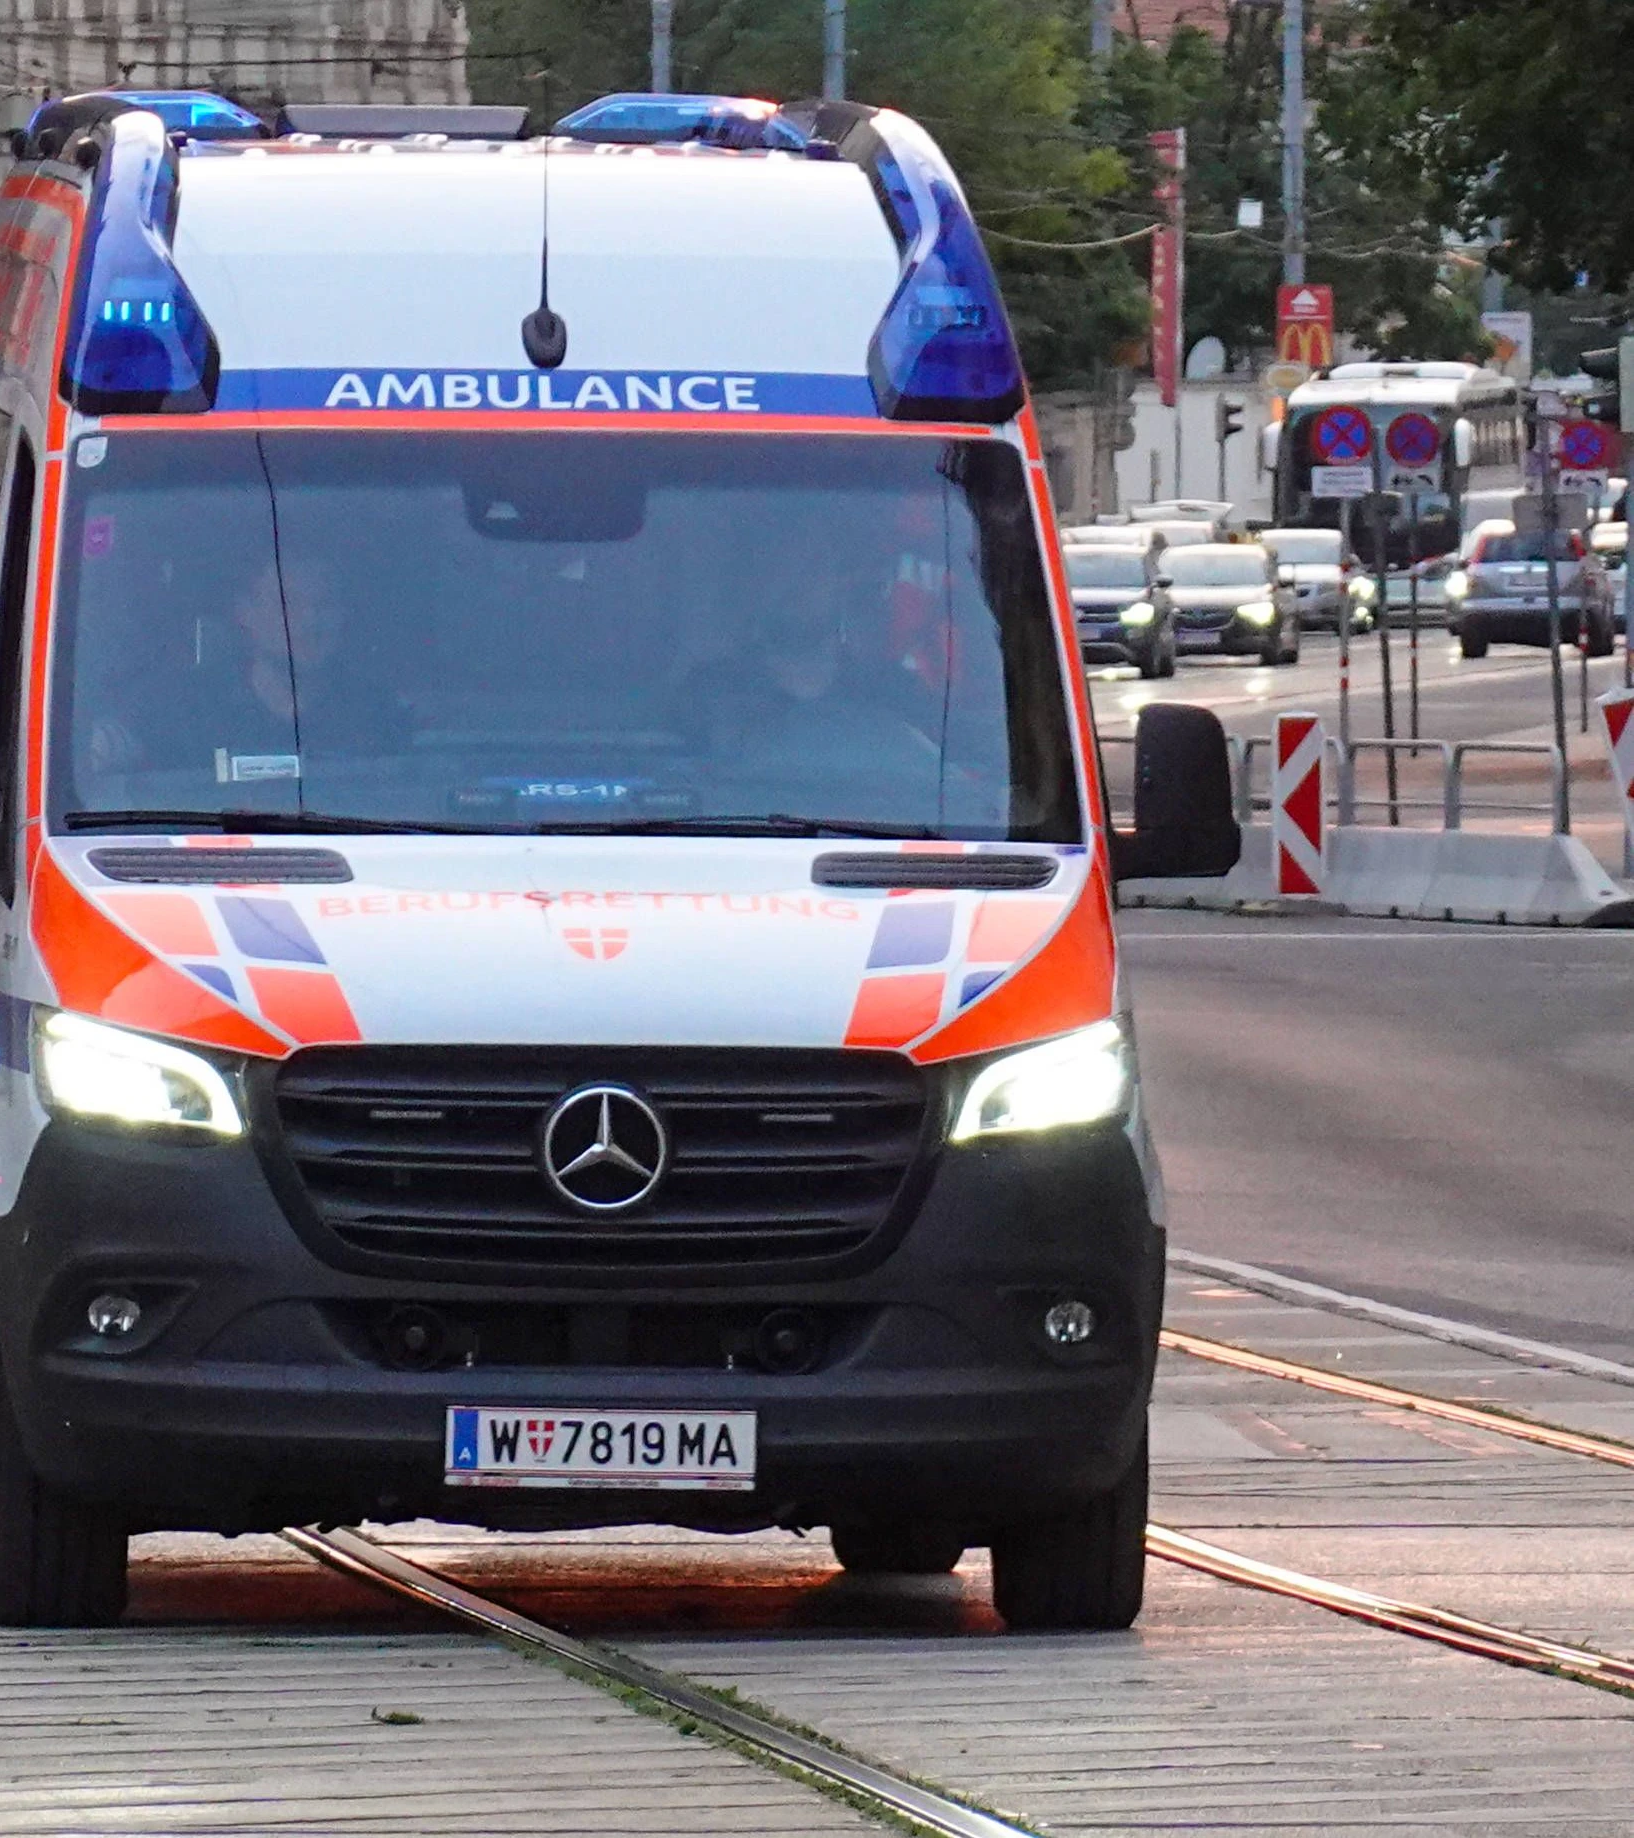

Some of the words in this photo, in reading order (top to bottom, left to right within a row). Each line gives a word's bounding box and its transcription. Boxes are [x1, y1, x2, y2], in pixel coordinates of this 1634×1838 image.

[324, 373, 761, 411] AMBULANCE
[317, 889, 861, 922] BERUFSRETTUNG
[458, 1446, 472, 1461] A
[489, 1418, 521, 1464] W
[560, 1420, 666, 1466] 7819
[677, 1421, 738, 1467] MA
